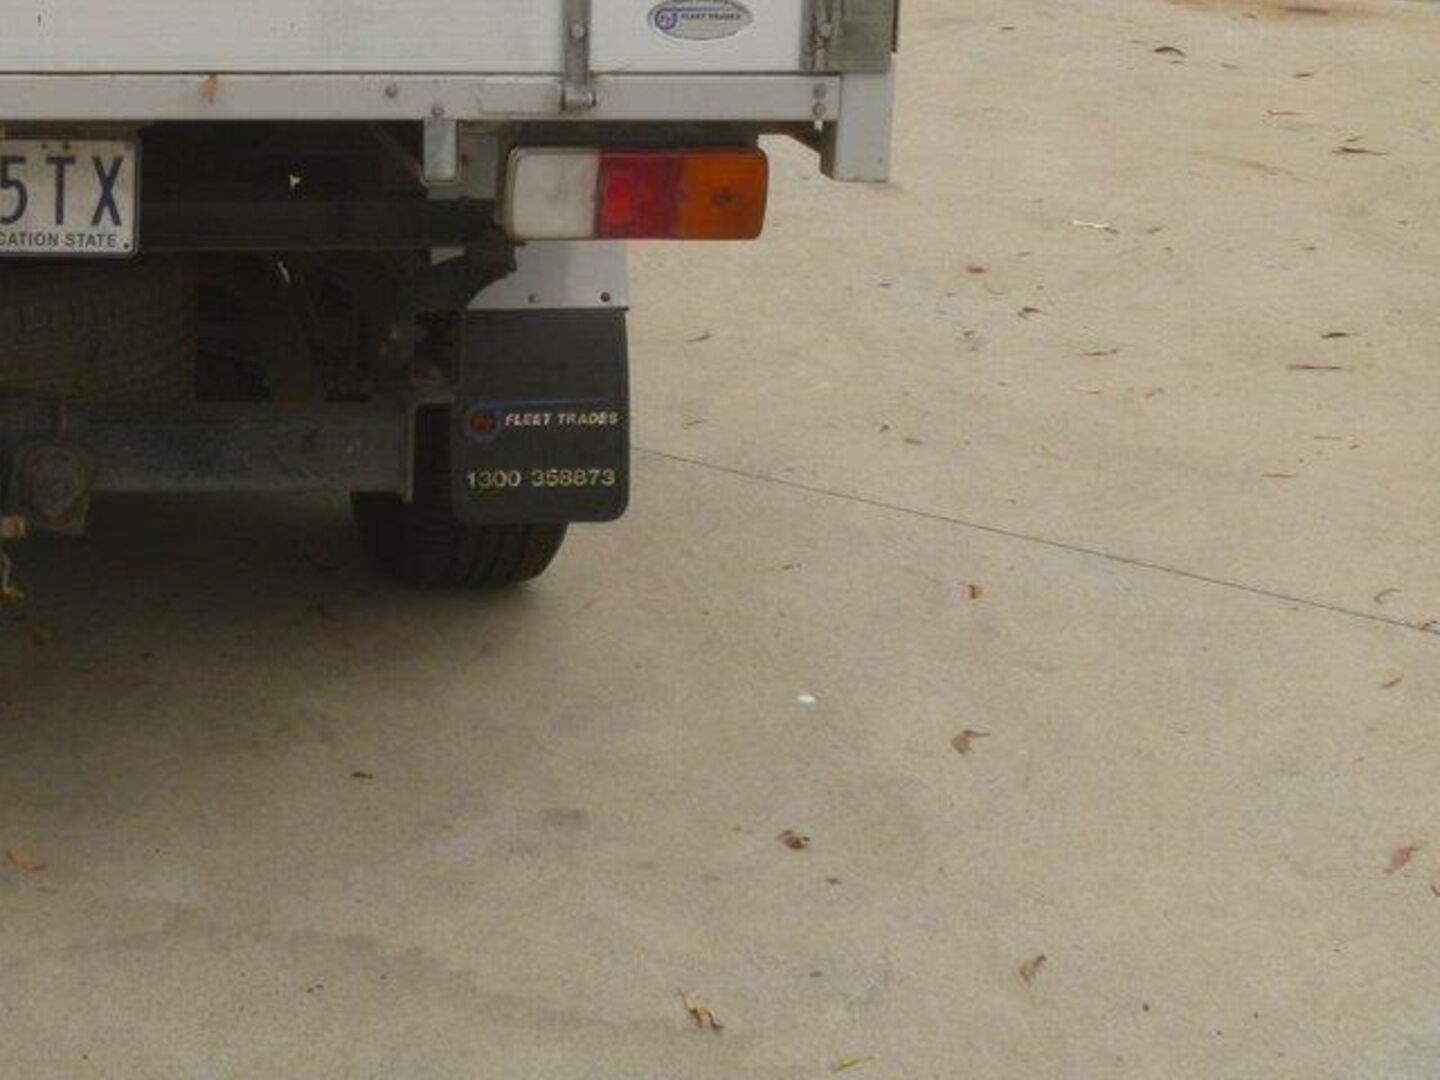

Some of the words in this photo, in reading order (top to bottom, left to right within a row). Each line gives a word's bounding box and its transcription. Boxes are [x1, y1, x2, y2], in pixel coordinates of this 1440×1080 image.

[64, 232, 118, 248] STATE
[505, 413, 552, 427] FLEET
[557, 411, 620, 426] TRADES
[467, 471, 522, 489] 1300
[530, 469, 616, 488] 358873
